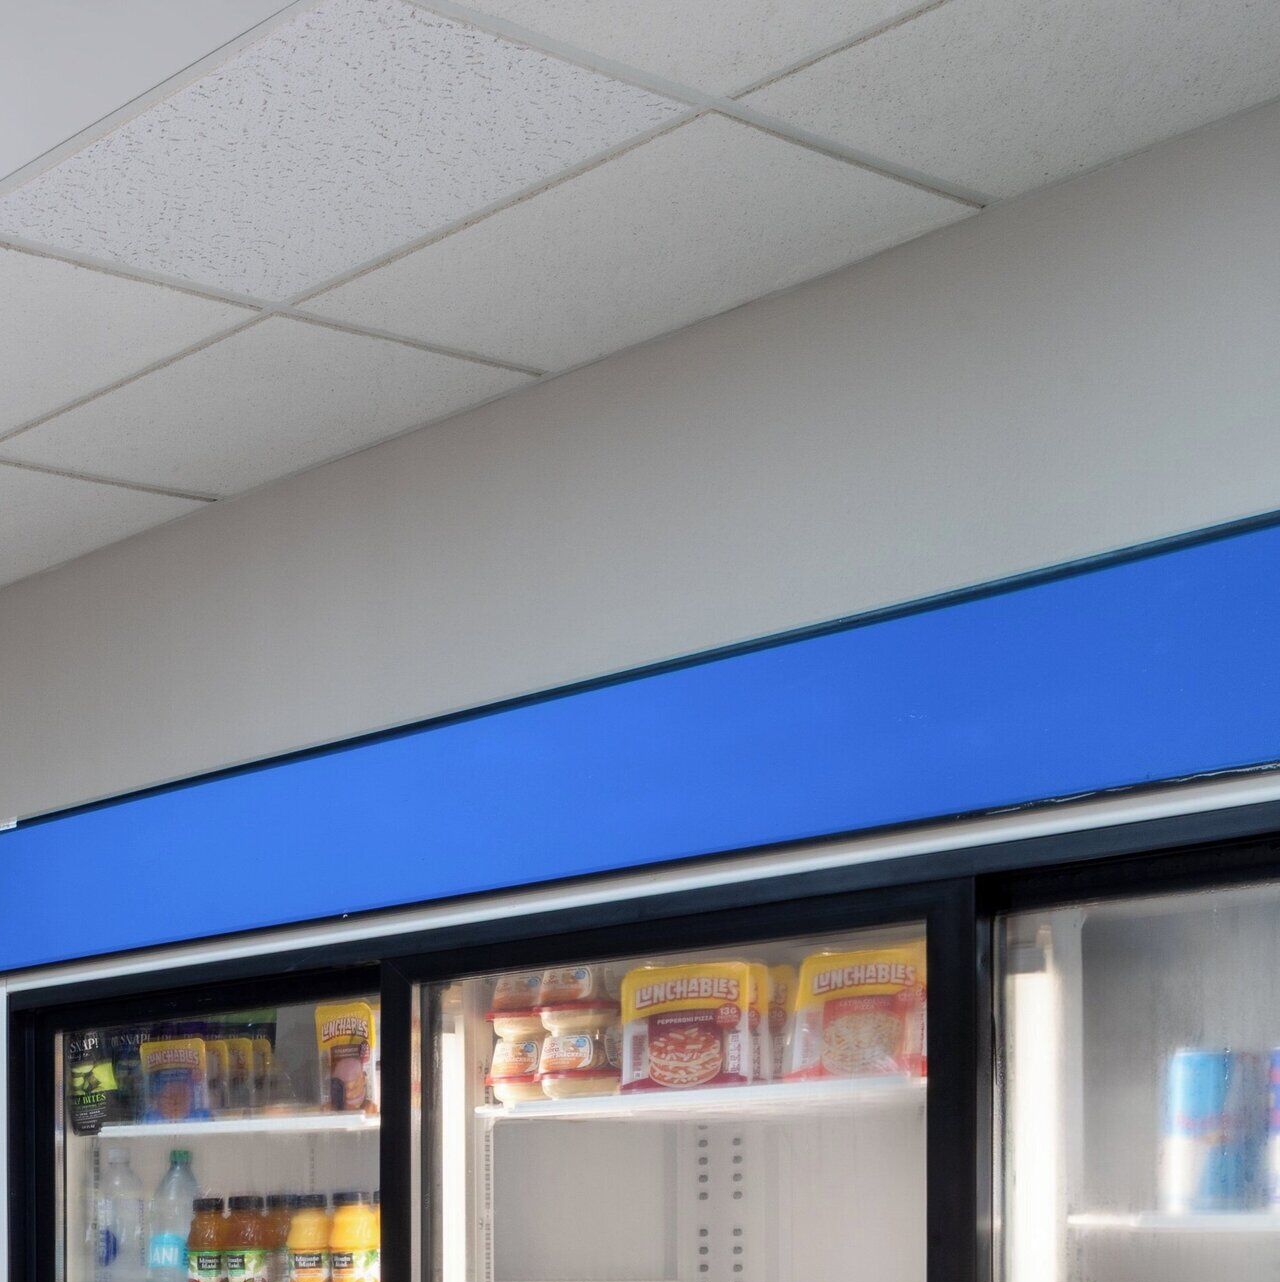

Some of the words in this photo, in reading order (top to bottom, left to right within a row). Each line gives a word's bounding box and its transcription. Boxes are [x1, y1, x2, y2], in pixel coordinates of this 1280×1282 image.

[634, 977, 740, 1009] LUNCHABLES
[813, 963, 916, 995] LUNCHABLES
[656, 1016, 694, 1025] PEPPERONI
[694, 1014, 713, 1022] PIZZA
